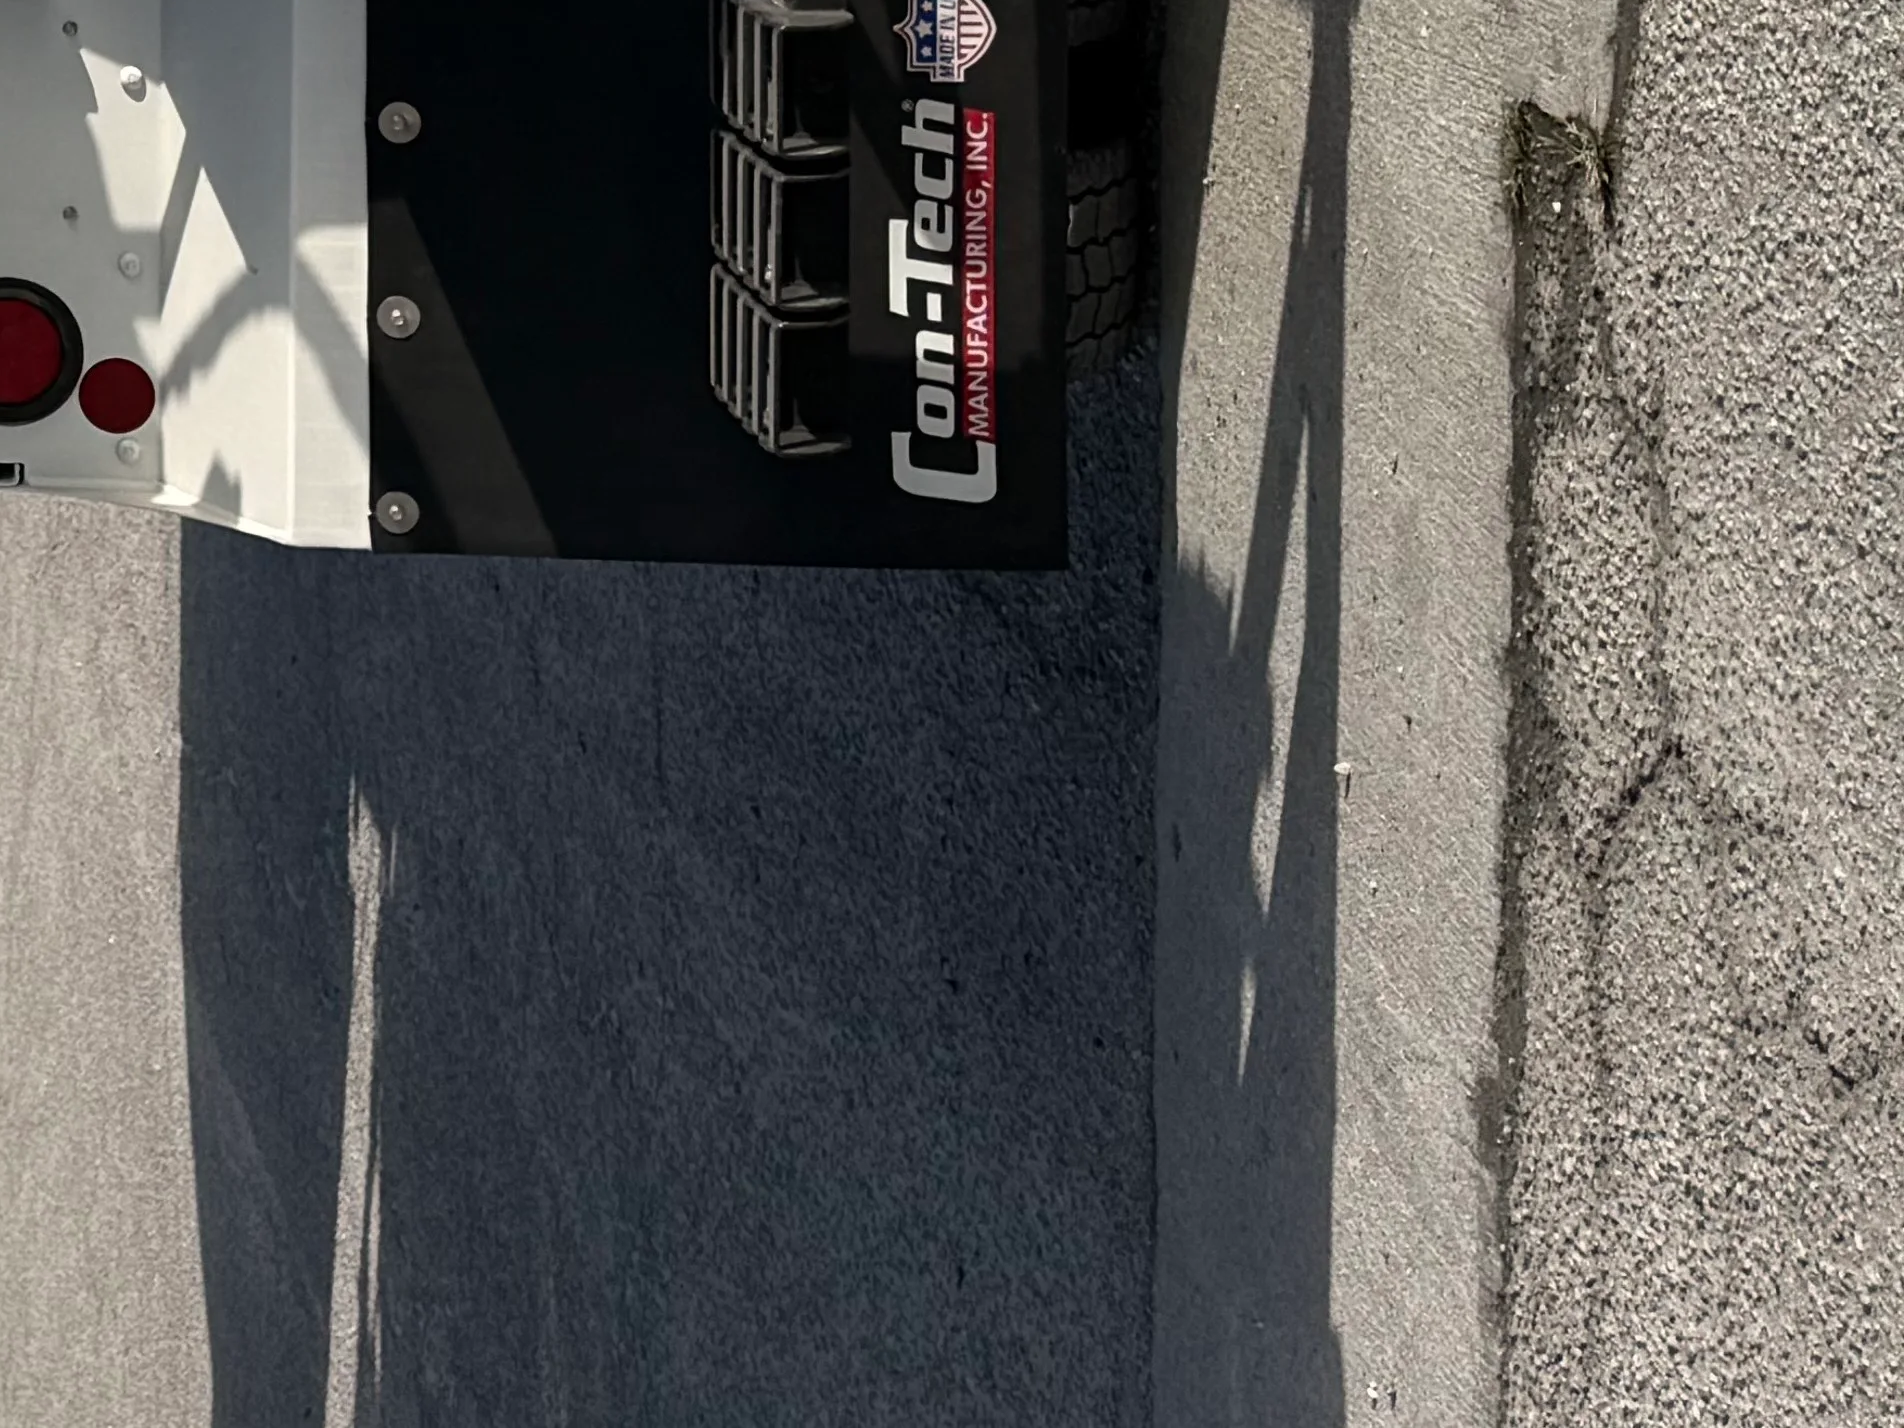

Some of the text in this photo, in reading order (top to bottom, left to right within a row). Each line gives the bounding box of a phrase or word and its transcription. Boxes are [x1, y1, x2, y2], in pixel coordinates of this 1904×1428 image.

[939, 16, 956, 31] IN
[939, 34, 956, 78] MADE
[965, 112, 992, 437] MANUFACTURING, INC.
